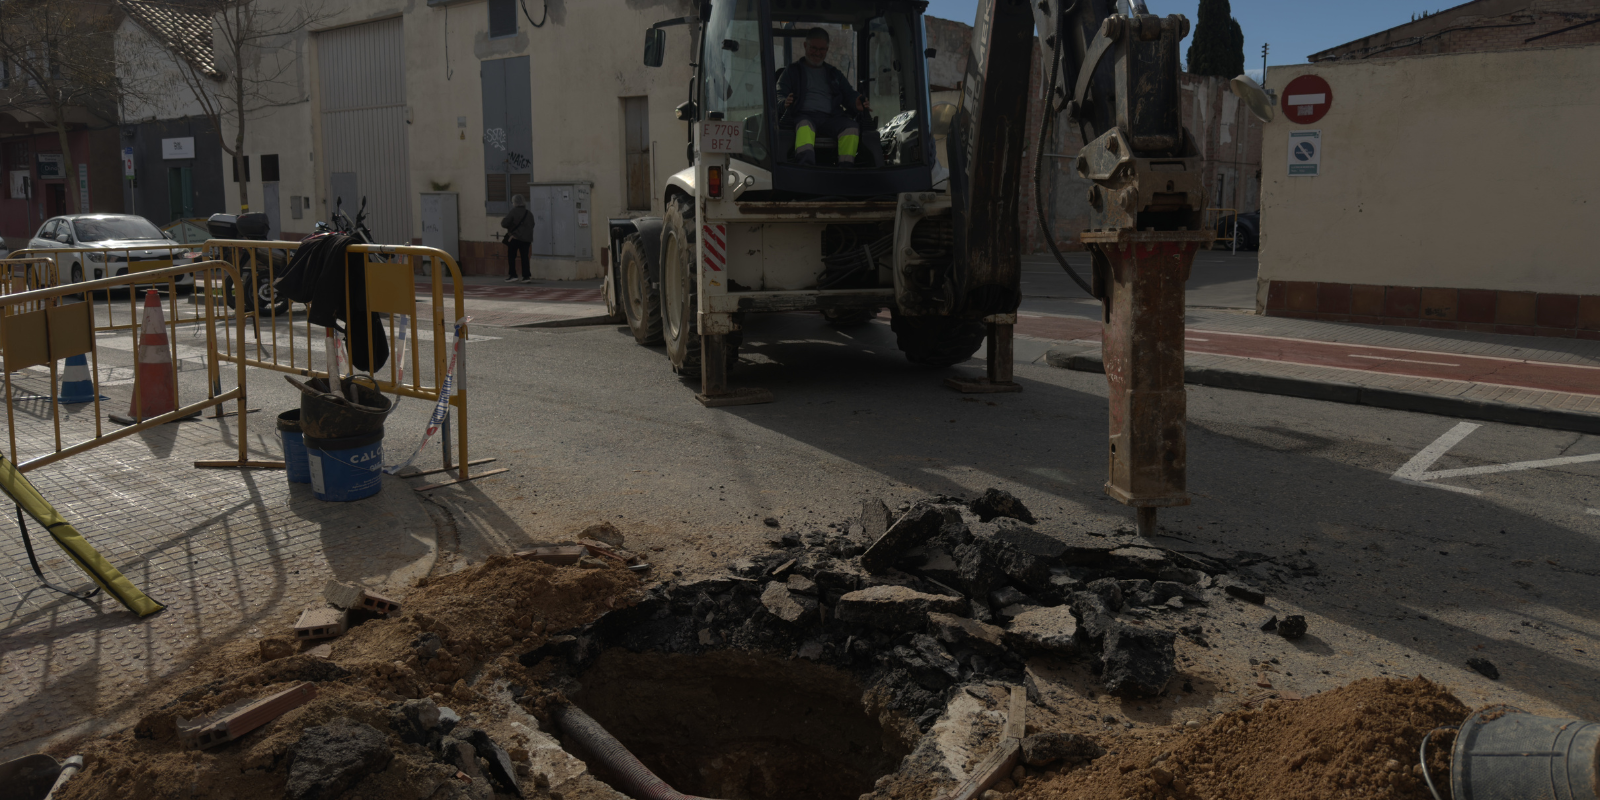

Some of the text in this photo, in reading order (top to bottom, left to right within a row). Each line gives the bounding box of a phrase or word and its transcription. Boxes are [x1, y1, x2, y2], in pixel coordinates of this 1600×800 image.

[965, 0, 993, 177] HIDROMEK
[704, 124, 710, 135] E
[712, 139, 732, 150] BFZ
[430, 374, 453, 425] POLICIA LOCAL
